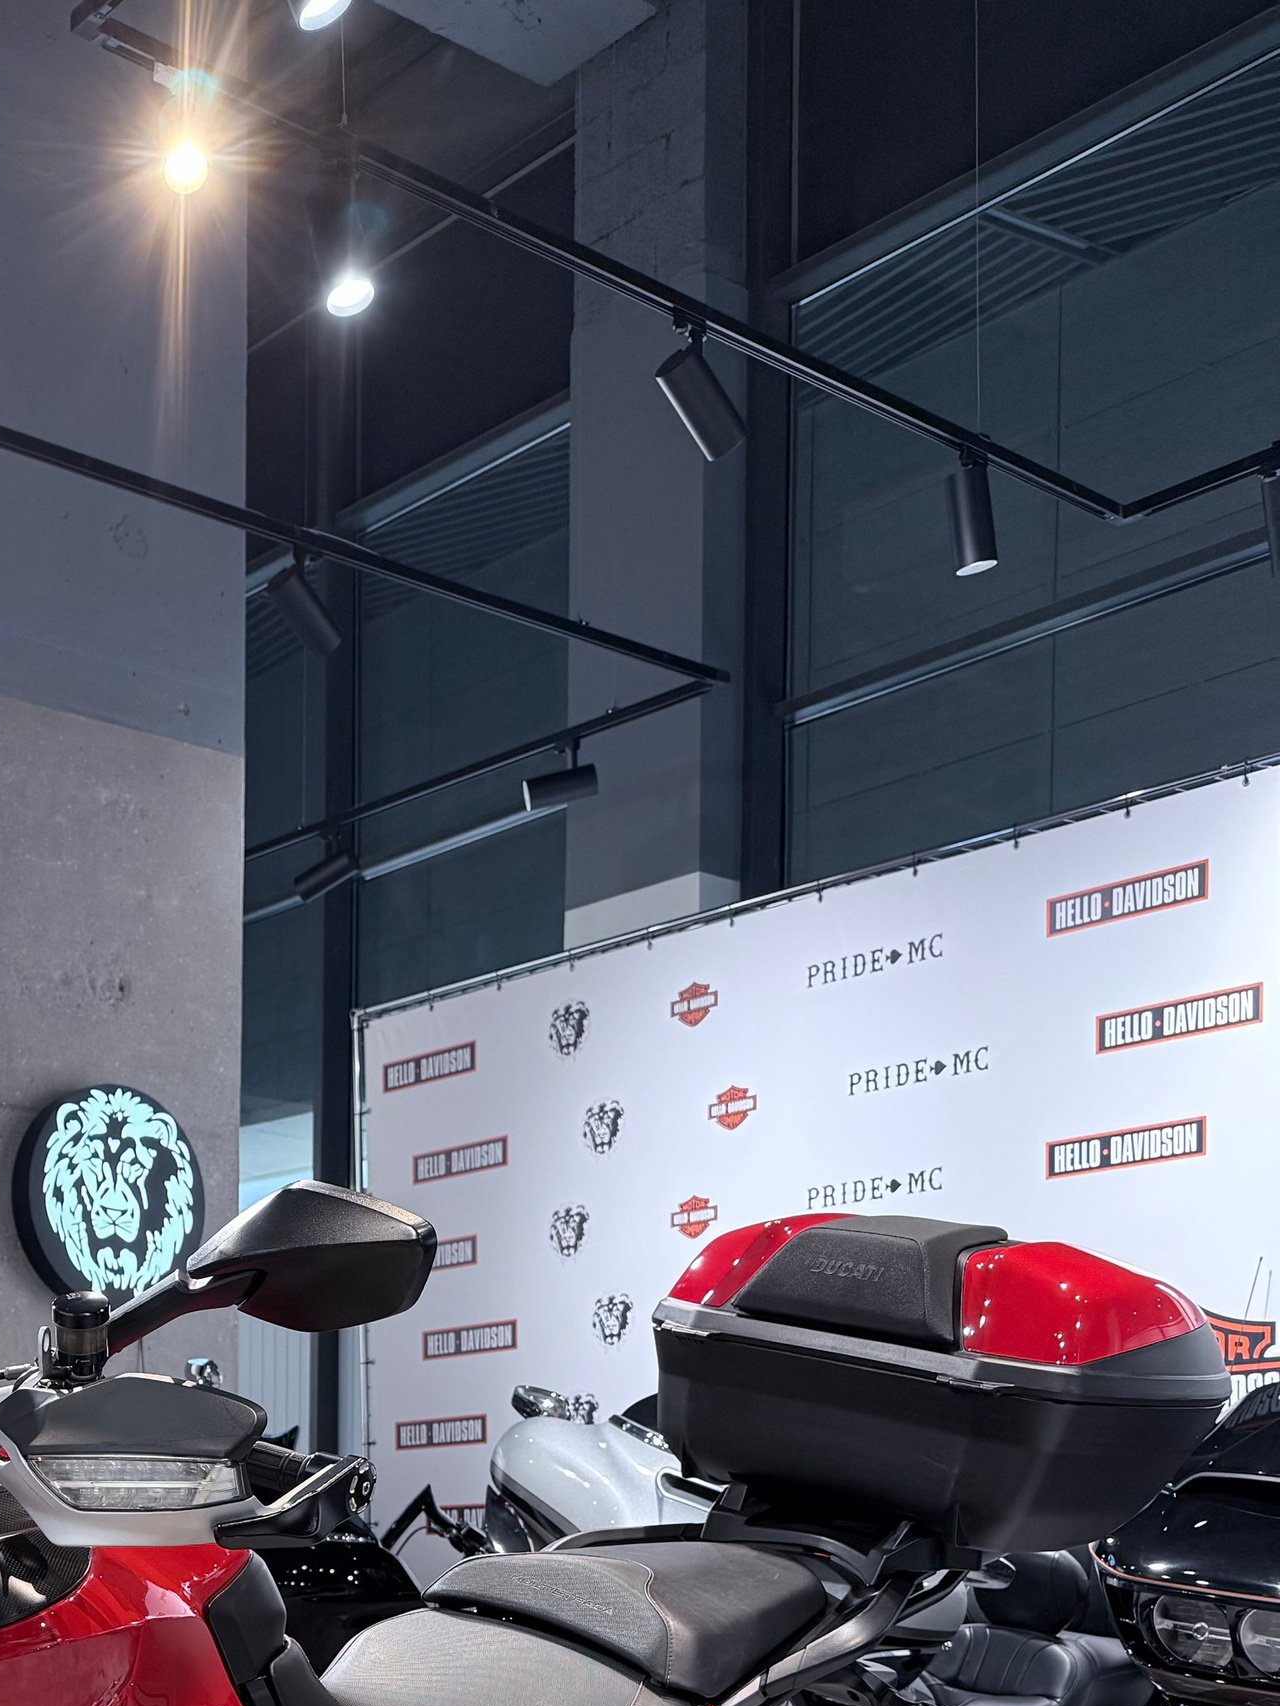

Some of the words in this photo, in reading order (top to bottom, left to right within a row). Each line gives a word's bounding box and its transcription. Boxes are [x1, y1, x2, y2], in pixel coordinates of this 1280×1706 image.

[1055, 892, 1102, 930] HELLO
[1112, 867, 1199, 915] DAVIDSON
[806, 946, 884, 988] PRIDE
[907, 932, 944, 965] MC
[1104, 1011, 1153, 1048] HELLO
[1163, 989, 1253, 1036] DAVIDSON
[387, 1061, 415, 1089] HELLO
[420, 1046, 471, 1080] DAVIDSON
[848, 1057, 928, 1096] PRIDE
[951, 1045, 989, 1077] MC
[417, 1153, 446, 1181] HELLO
[450, 1140, 503, 1173] DAVIDSON
[1054, 1139, 1101, 1174] HELLO
[1110, 1122, 1197, 1165] DAVIDSON
[807, 1175, 884, 1210] PRIDE
[907, 1166, 943, 1195] MC
[433, 1240, 473, 1267] VIDSON
[809, 1256, 884, 1282] DUCATI
[427, 1331, 455, 1357] HELLO
[460, 1324, 513, 1352] DAVIDSON
[400, 1424, 427, 1447] HELLO
[432, 1418, 482, 1444] DAVIDSON
